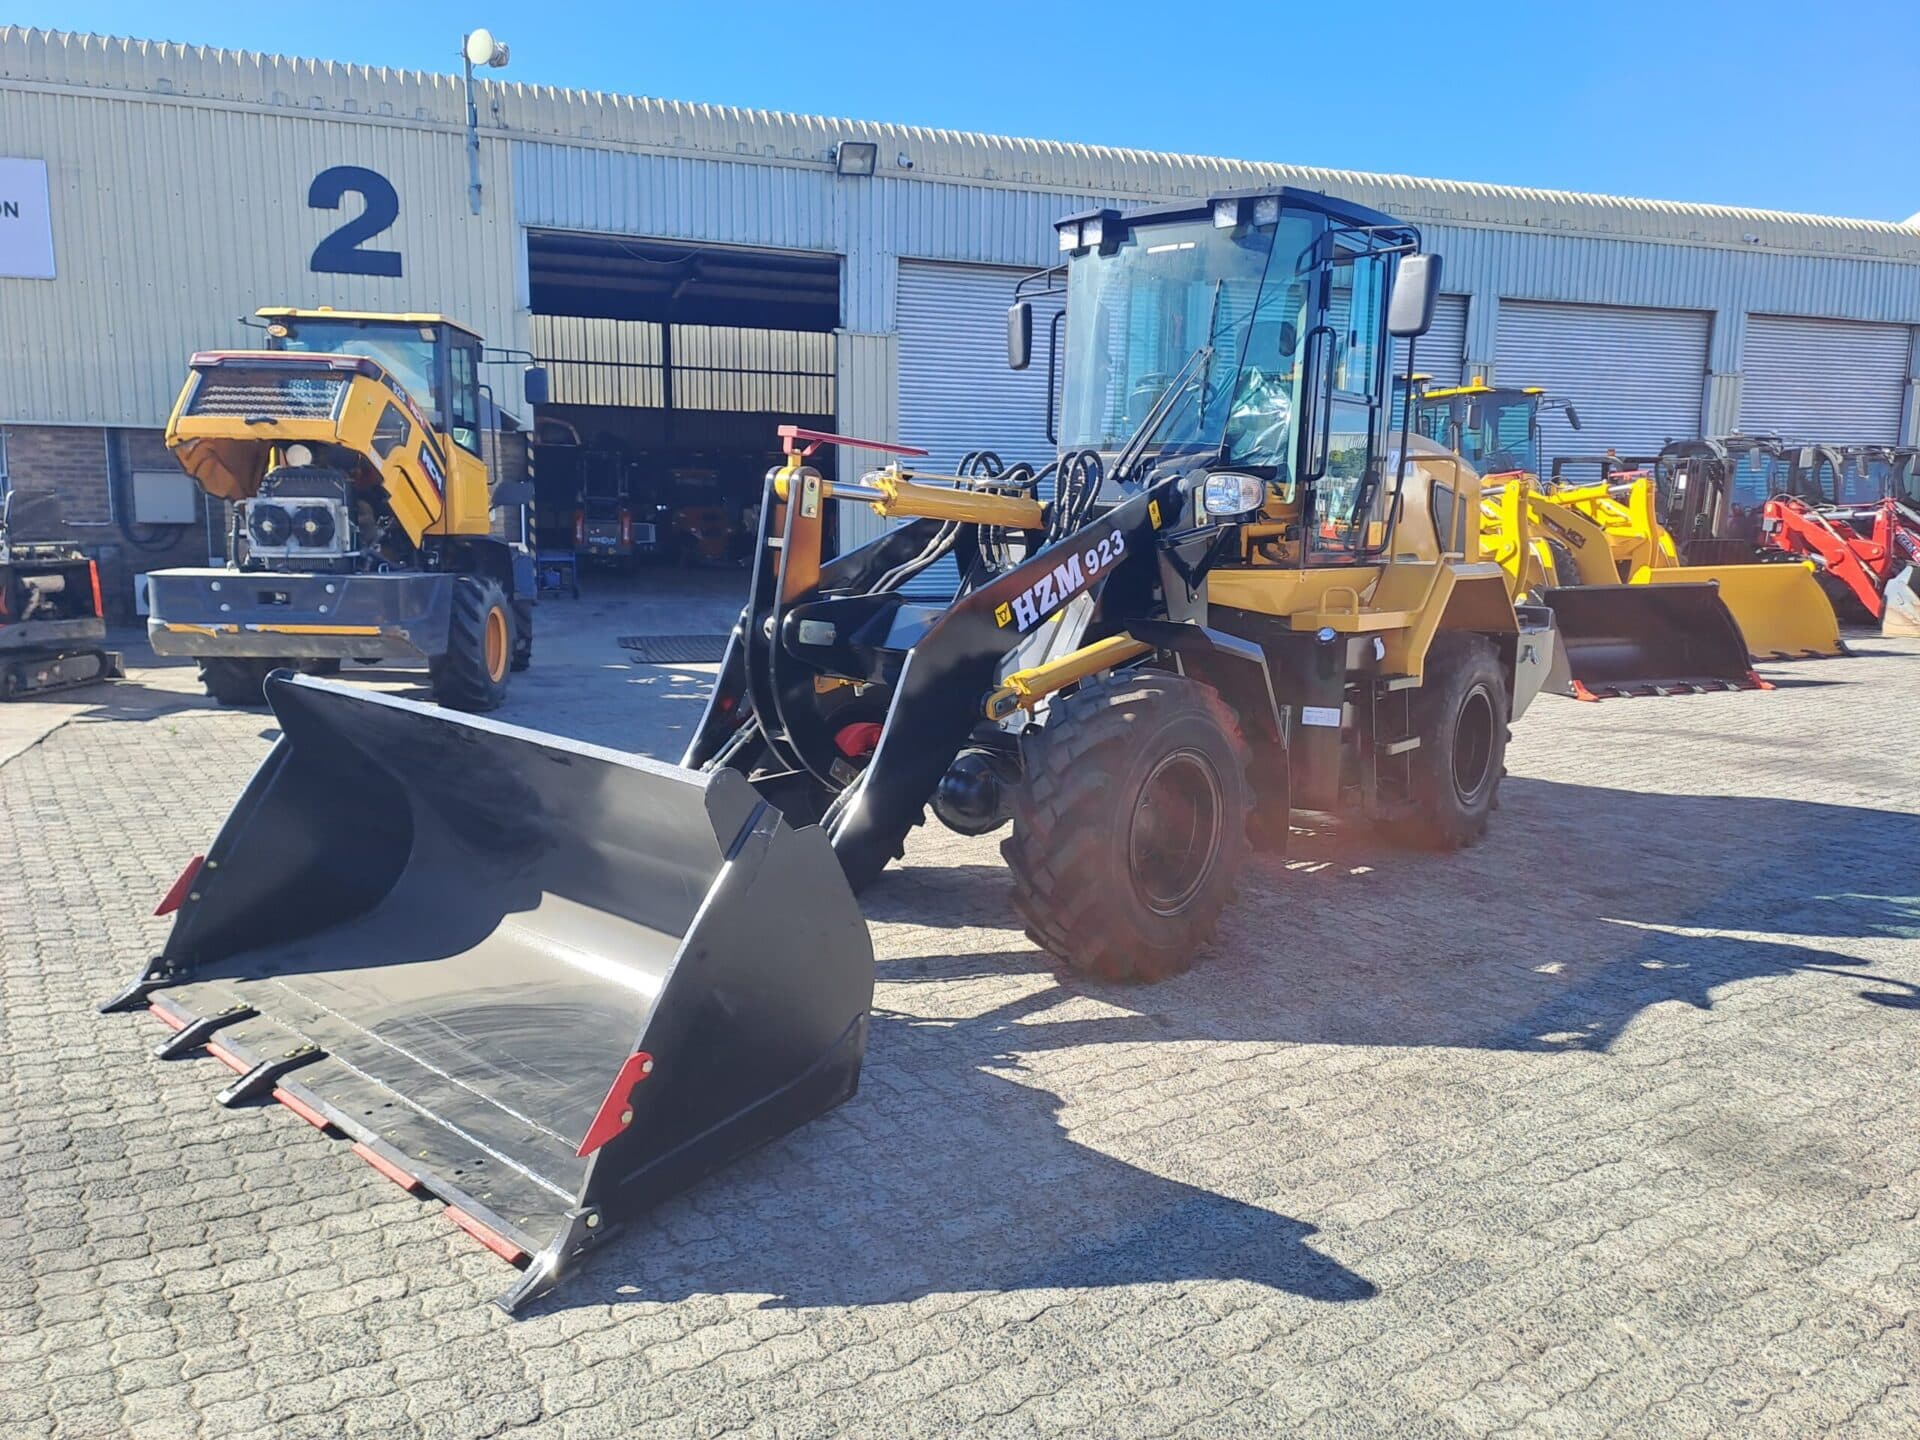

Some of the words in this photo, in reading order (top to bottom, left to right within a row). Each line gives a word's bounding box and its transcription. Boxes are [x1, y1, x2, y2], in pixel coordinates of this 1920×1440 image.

[0, 201, 19, 219] N
[308, 166, 403, 278] 2
[1011, 553, 1085, 633] HZM
[1085, 529, 1125, 576] 923
